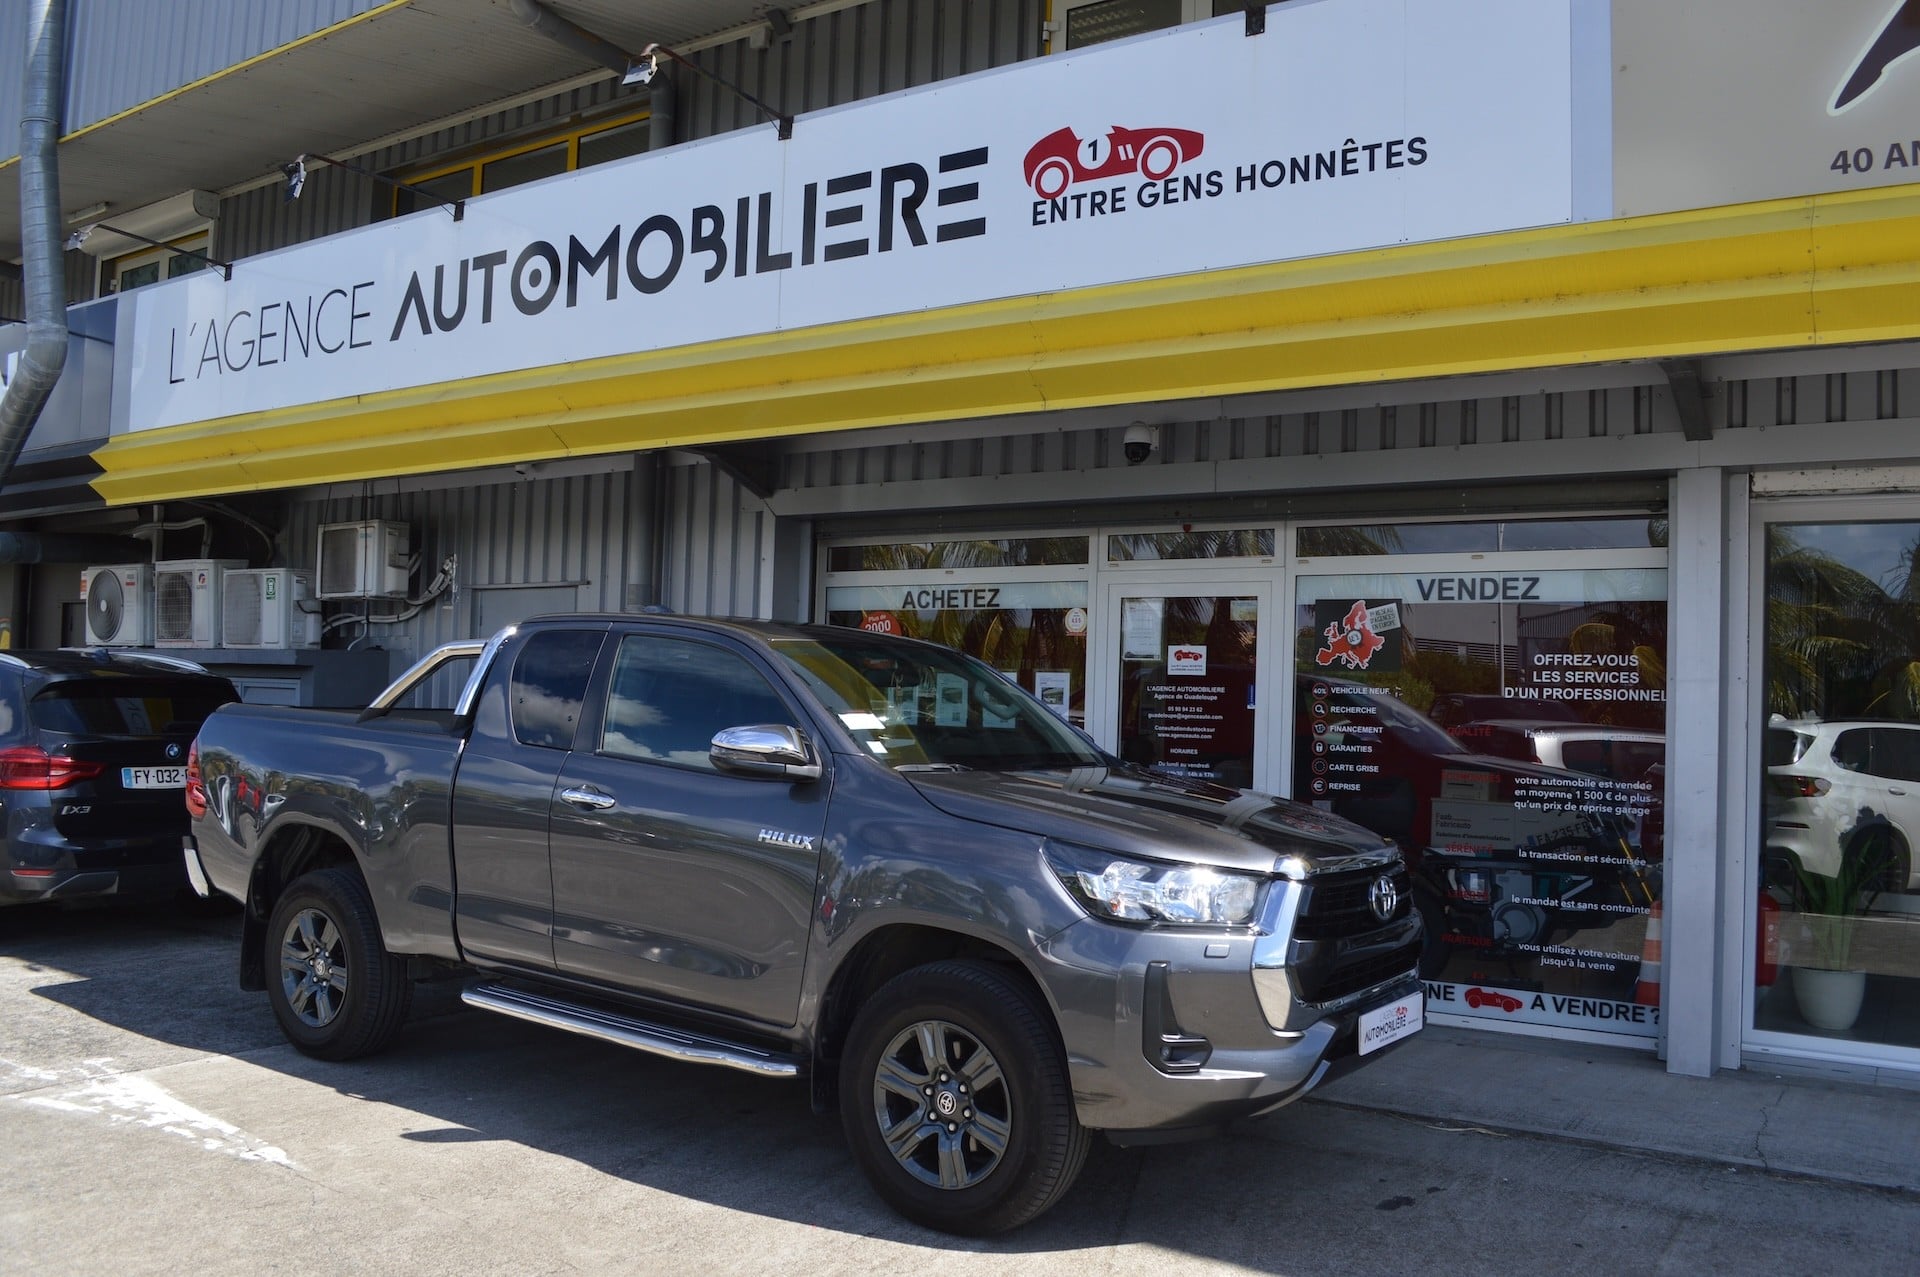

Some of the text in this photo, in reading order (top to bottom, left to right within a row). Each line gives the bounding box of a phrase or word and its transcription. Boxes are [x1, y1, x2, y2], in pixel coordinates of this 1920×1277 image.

[1088, 139, 1098, 162] 1
[1830, 147, 1873, 175] 40
[1031, 136, 1428, 226] ENTRE GENS HONNÊTES
[169, 146, 988, 384] L'AGENCE AUTOMOBILIERE
[1416, 577, 1540, 601] VENDEZ
[902, 588, 1000, 609] ACHETEZ
[1534, 654, 1639, 667] OFFREZ-VOUS
[1533, 671, 1640, 684] LES SERVICES
[1331, 687, 1368, 695] VEHICULE
[1504, 687, 1667, 702] D'UN PROFESSIONNEL
[1330, 706, 1377, 714] RECHERCHE
[1329, 726, 1384, 734] FINANCEMENT
[1329, 744, 1373, 753] GARANTIES
[134, 768, 188, 784] FY-032-
[1329, 764, 1379, 773] CARTE GRISE
[1329, 782, 1361, 791] REPRISE
[1515, 777, 1539, 785] votre
[1541, 777, 1596, 788] automobile
[1598, 781, 1613, 789] est
[1515, 789, 1527, 797] en
[1529, 789, 1573, 799] moyenne
[1584, 791, 1603, 800] 500
[1605, 791, 1613, 801] €
[1614, 792, 1628, 801] de
[1630, 793, 1651, 803] plus
[1515, 800, 1651, 817] qu'un prix de reprise garage
[758, 828, 815, 850] HILUX
[1519, 849, 1647, 867] la transaction est sécurisée
[1511, 894, 1651, 915] le mandat est sans contrainte
[1518, 943, 1640, 961] vous utilisez votre voiture
[1541, 956, 1616, 972] jusqu'à la vente
[1424, 982, 1455, 1001] NE
[1530, 994, 1546, 1012] A
[1552, 996, 1645, 1024] VENDRE
